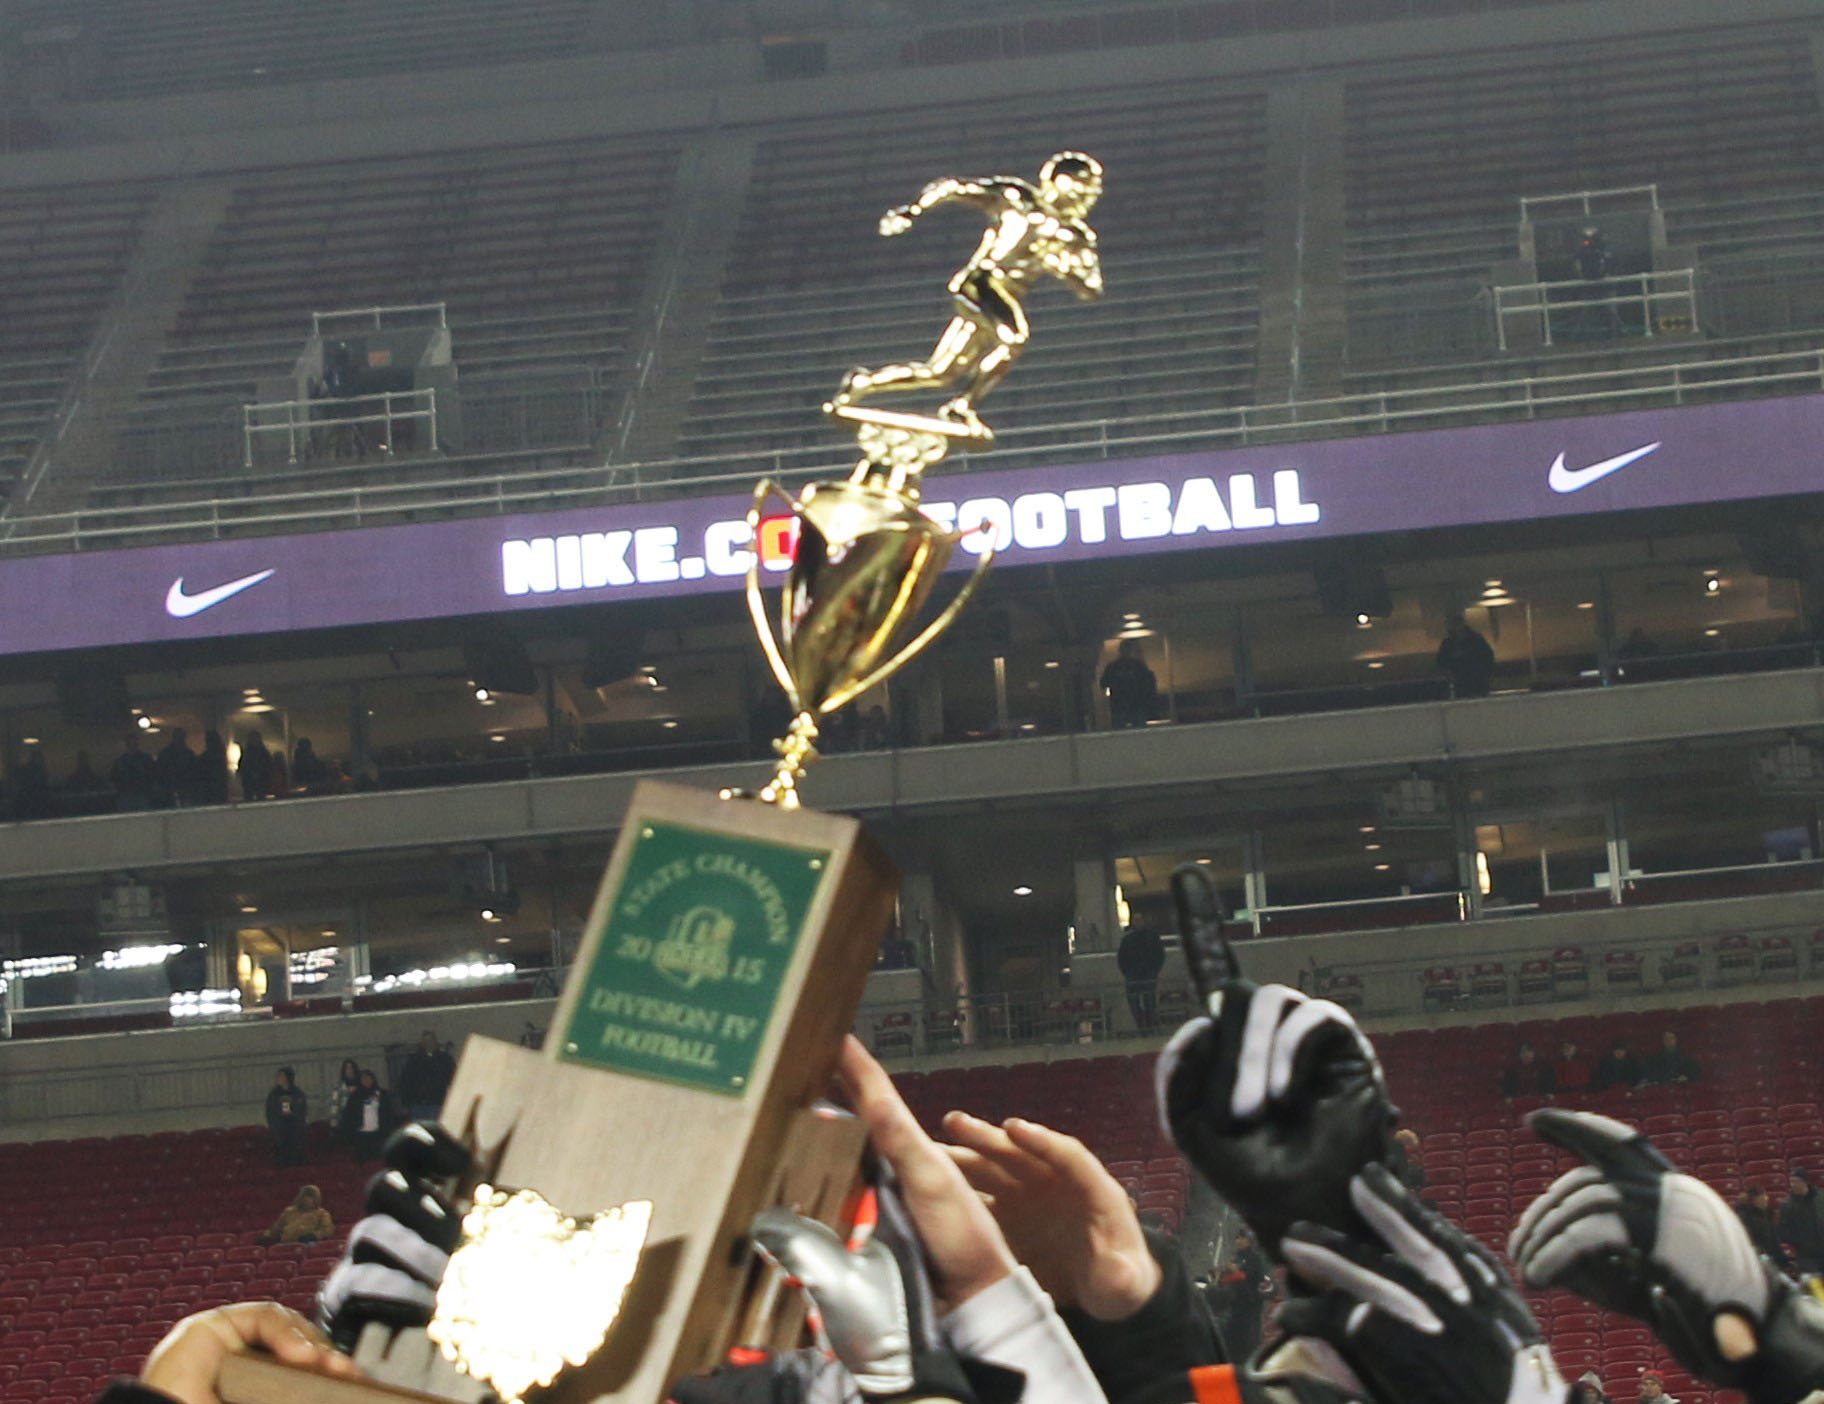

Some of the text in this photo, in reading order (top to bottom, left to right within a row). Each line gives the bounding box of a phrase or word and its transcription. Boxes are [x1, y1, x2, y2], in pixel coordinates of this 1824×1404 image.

[501, 469, 1320, 596] NIKE.COOOTBALL
[623, 853, 789, 945] STATE CHAMPION
[616, 934, 653, 961] 20
[733, 957, 767, 984] 15
[589, 987, 759, 1041] DIVISION IV
[602, 1024, 717, 1069] FOOTBALL
